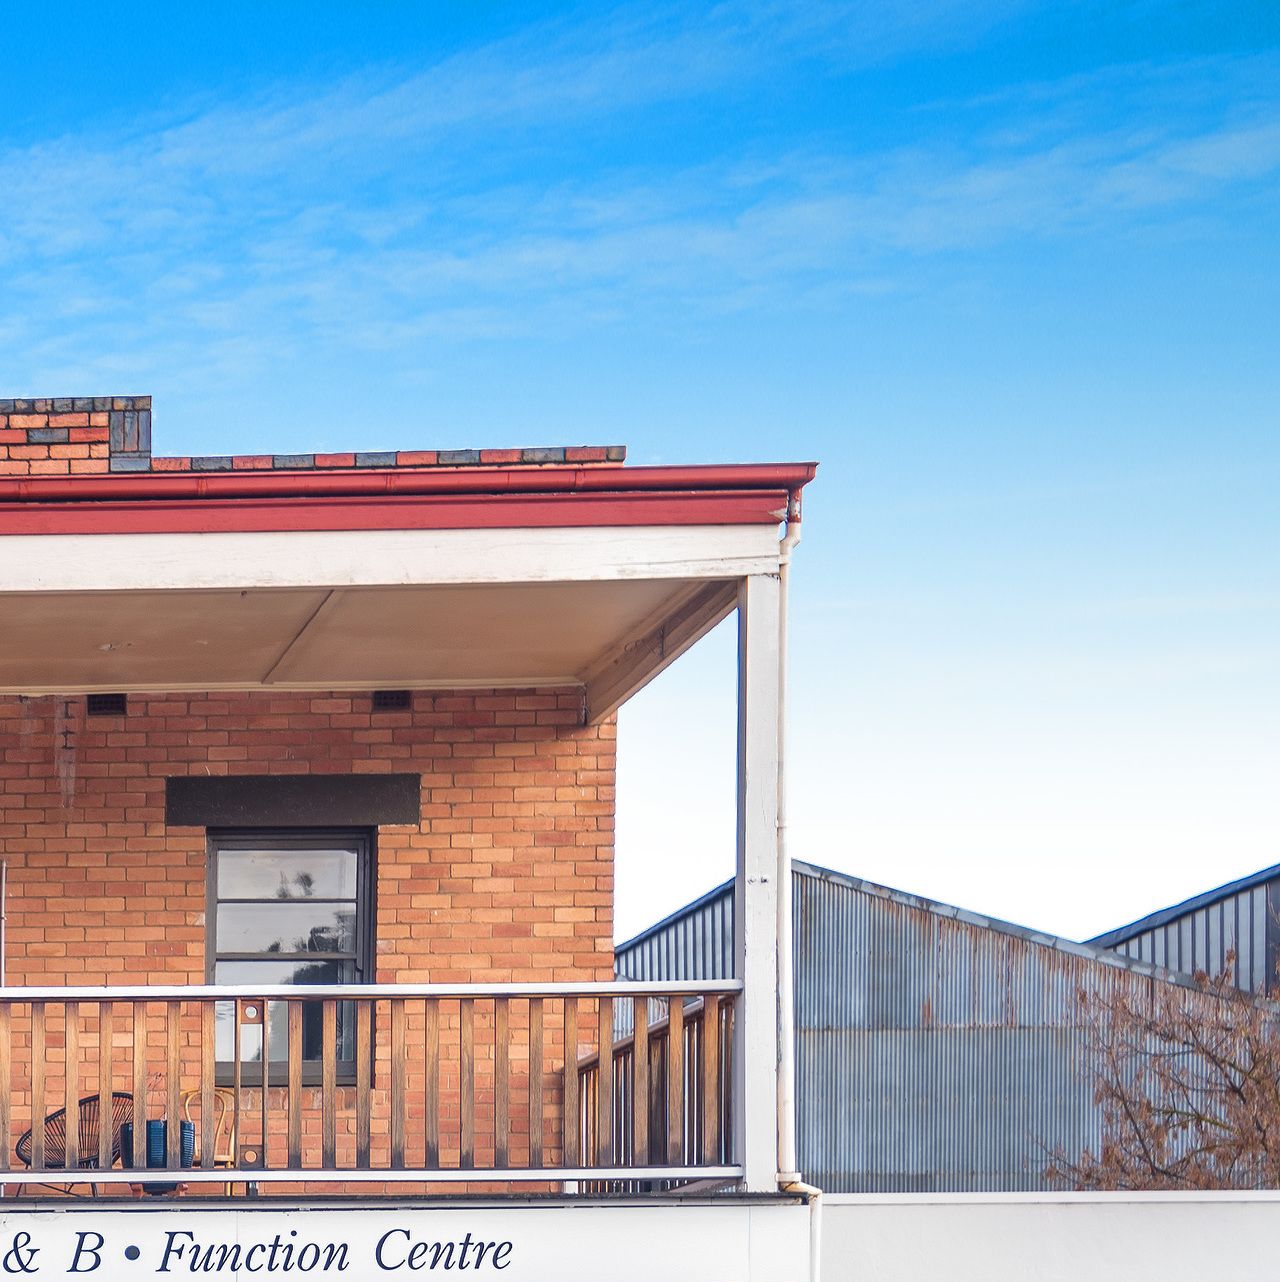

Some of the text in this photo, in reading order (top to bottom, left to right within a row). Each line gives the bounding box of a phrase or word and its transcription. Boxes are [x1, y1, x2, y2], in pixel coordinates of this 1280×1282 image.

[2, 1231, 41, 1274] &
[65, 1231, 105, 1273] B
[154, 1229, 350, 1273] Function
[375, 1228, 513, 1271] Centre
